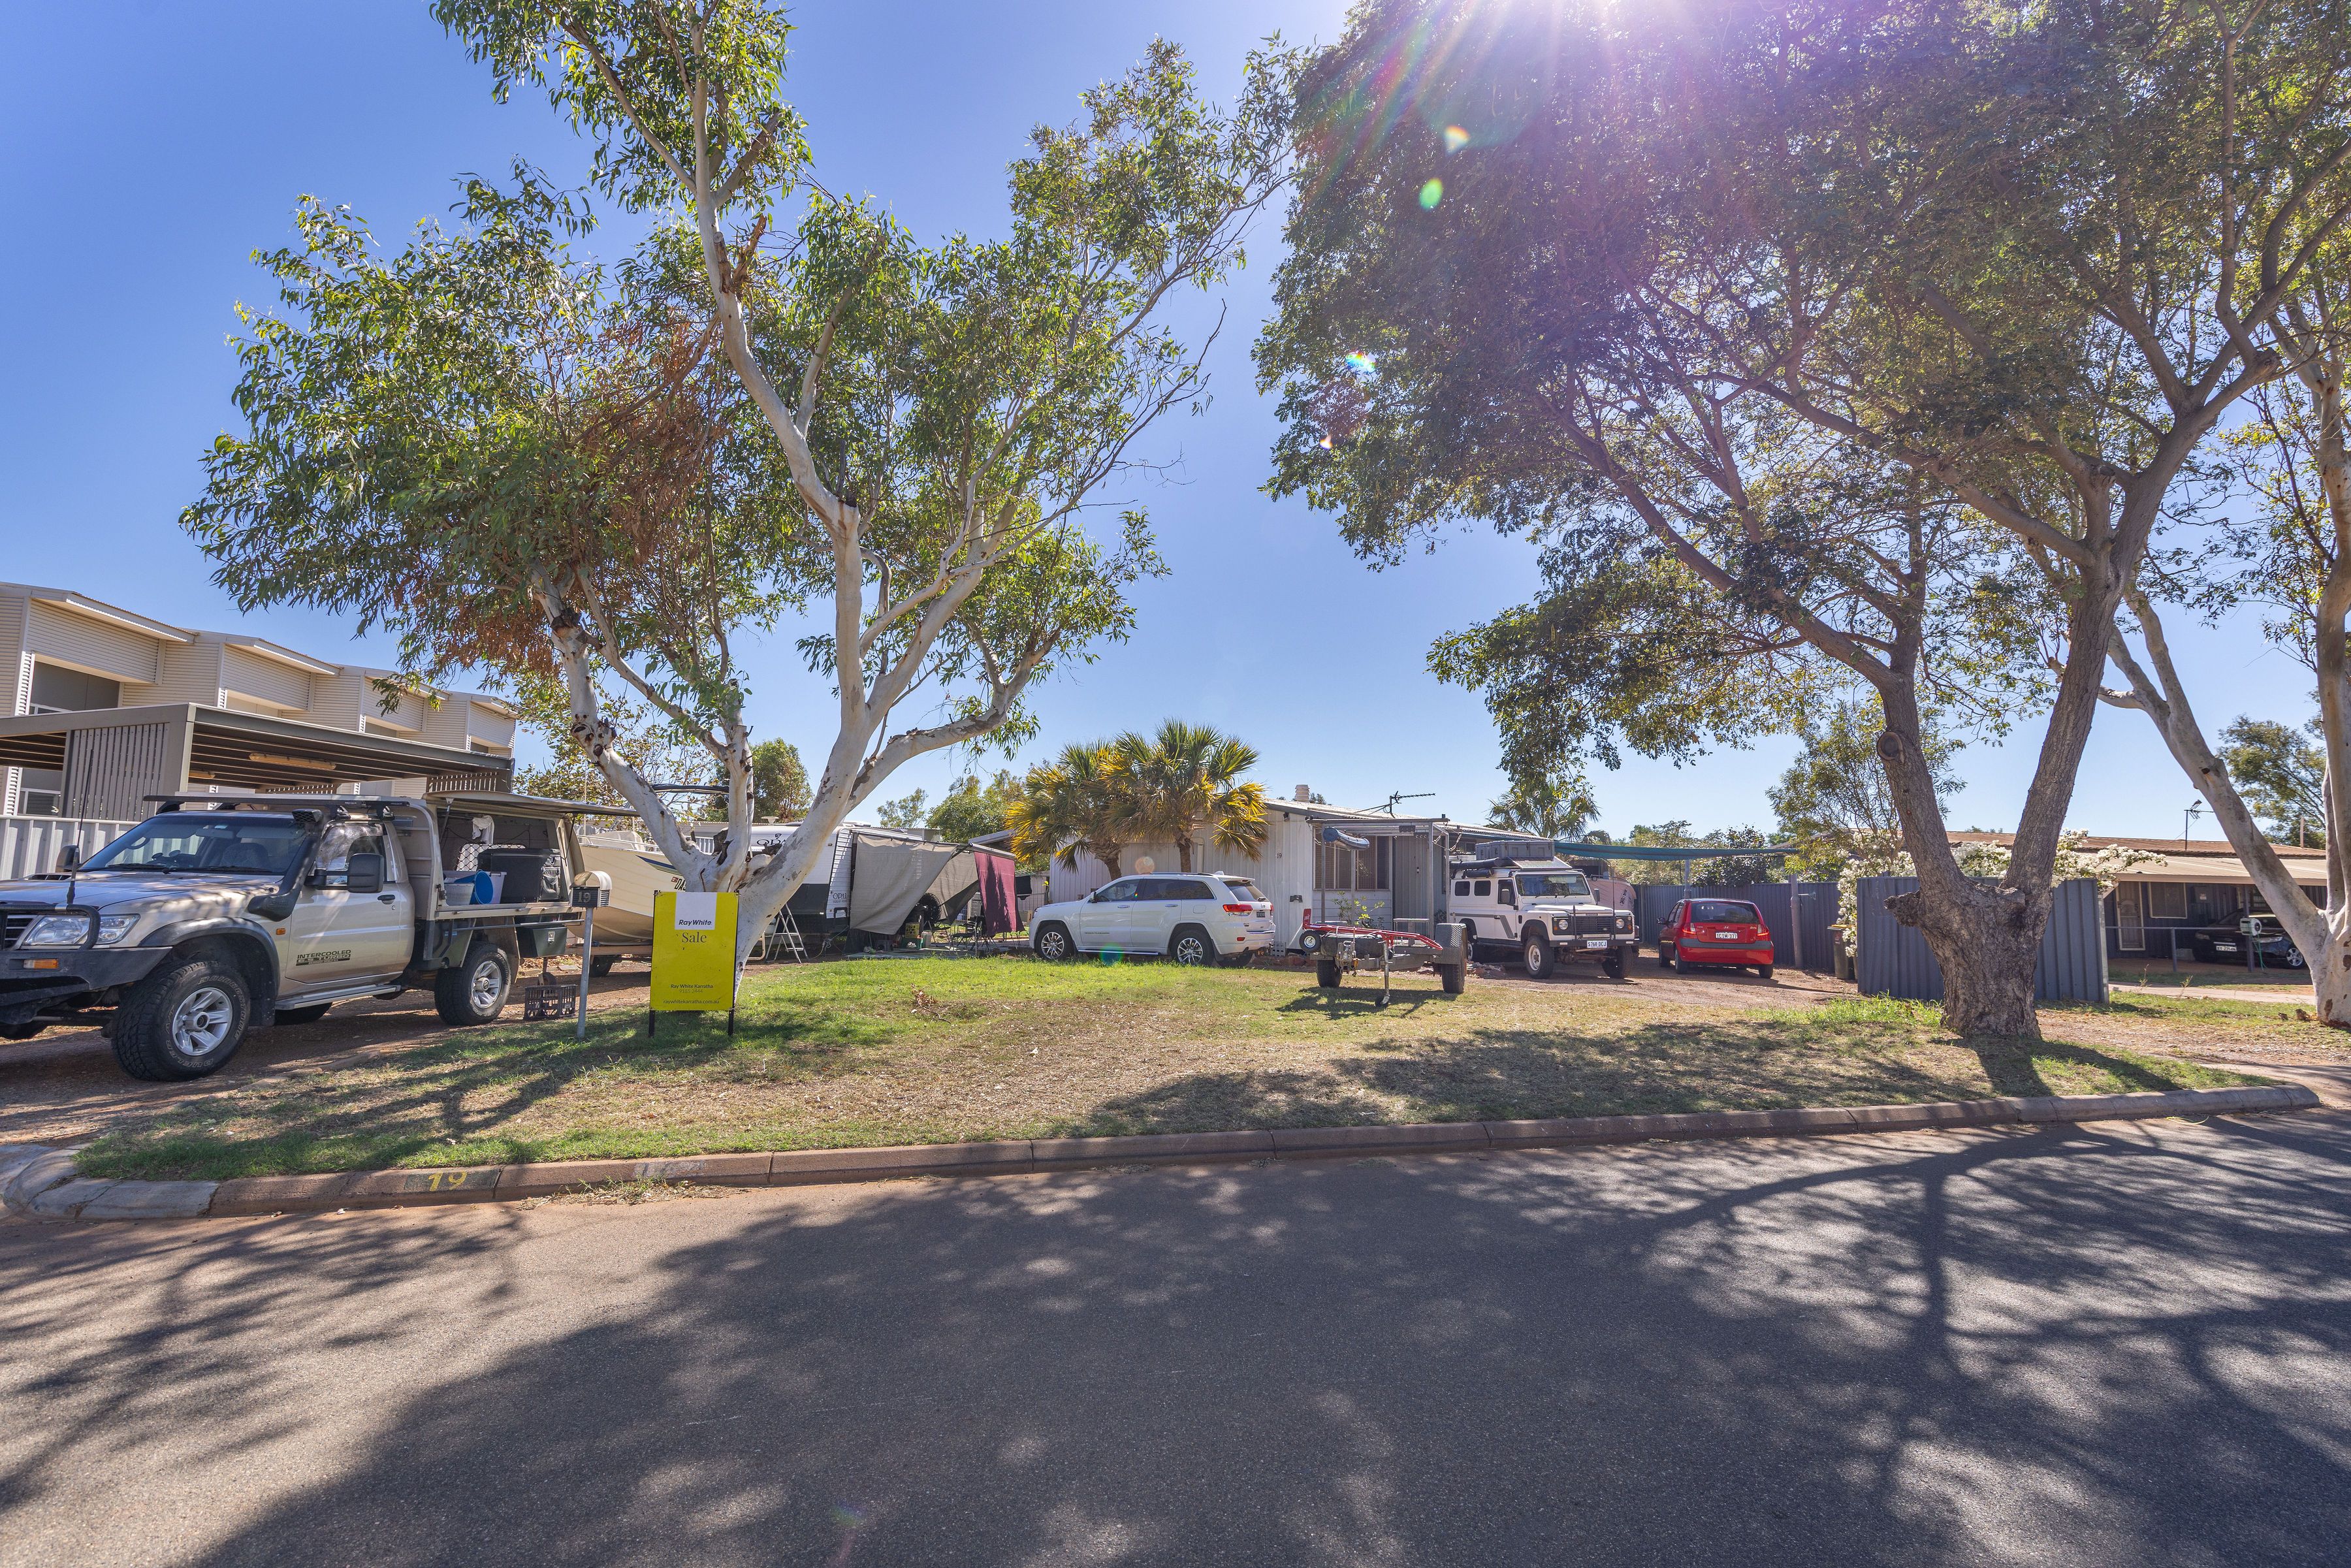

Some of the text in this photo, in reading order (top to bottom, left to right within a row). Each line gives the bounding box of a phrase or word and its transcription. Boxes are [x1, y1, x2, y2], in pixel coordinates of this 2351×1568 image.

[577, 891, 591, 903] 19
[682, 931, 707, 943] Sale
[297, 950, 351, 959] INTERCOOLED
[428, 1170, 468, 1192] 19
